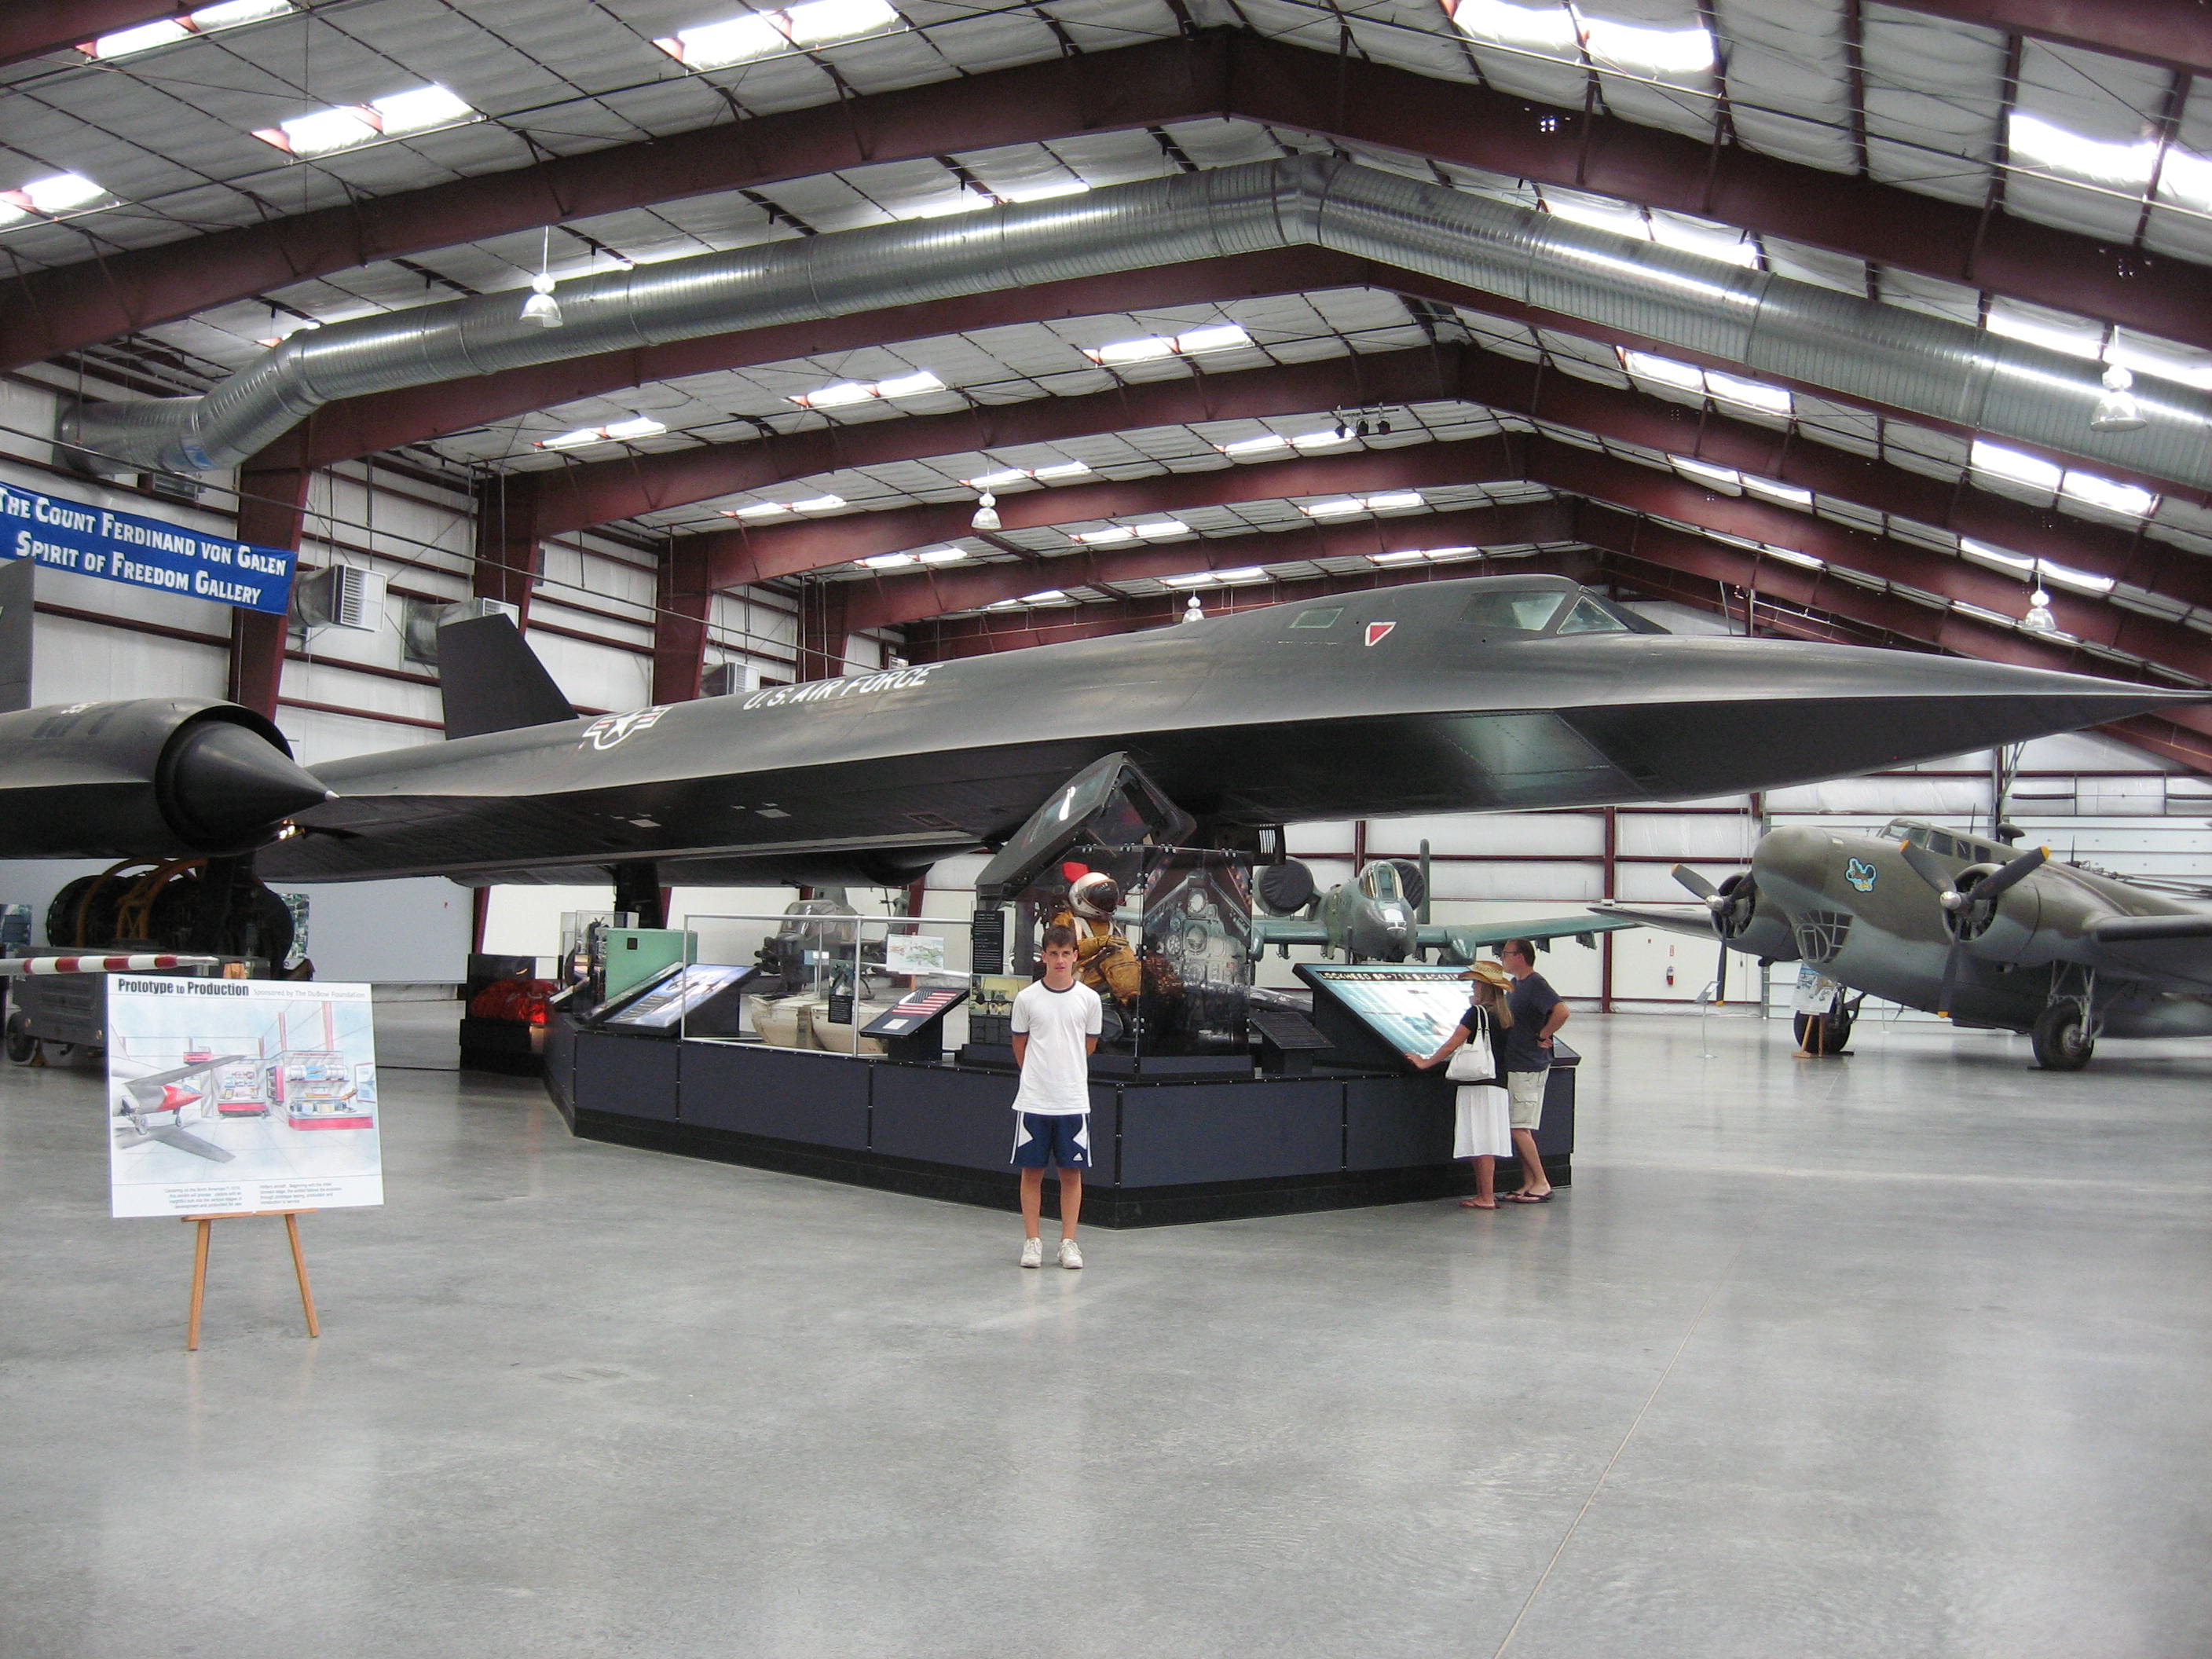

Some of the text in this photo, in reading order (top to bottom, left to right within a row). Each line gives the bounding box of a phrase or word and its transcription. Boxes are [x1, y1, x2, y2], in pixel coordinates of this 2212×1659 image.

[0, 489, 287, 577] THE COUNT FERDINAND VON GALEN
[16, 531, 262, 605] SPIRIT OF FREEDOM GALLERY
[789, 679, 845, 704] AIR
[840, 664, 944, 697] FORCE
[118, 979, 174, 995] Prototype
[177, 984, 185, 994] to
[188, 981, 249, 997] Production
[254, 989, 284, 998] Sponsored
